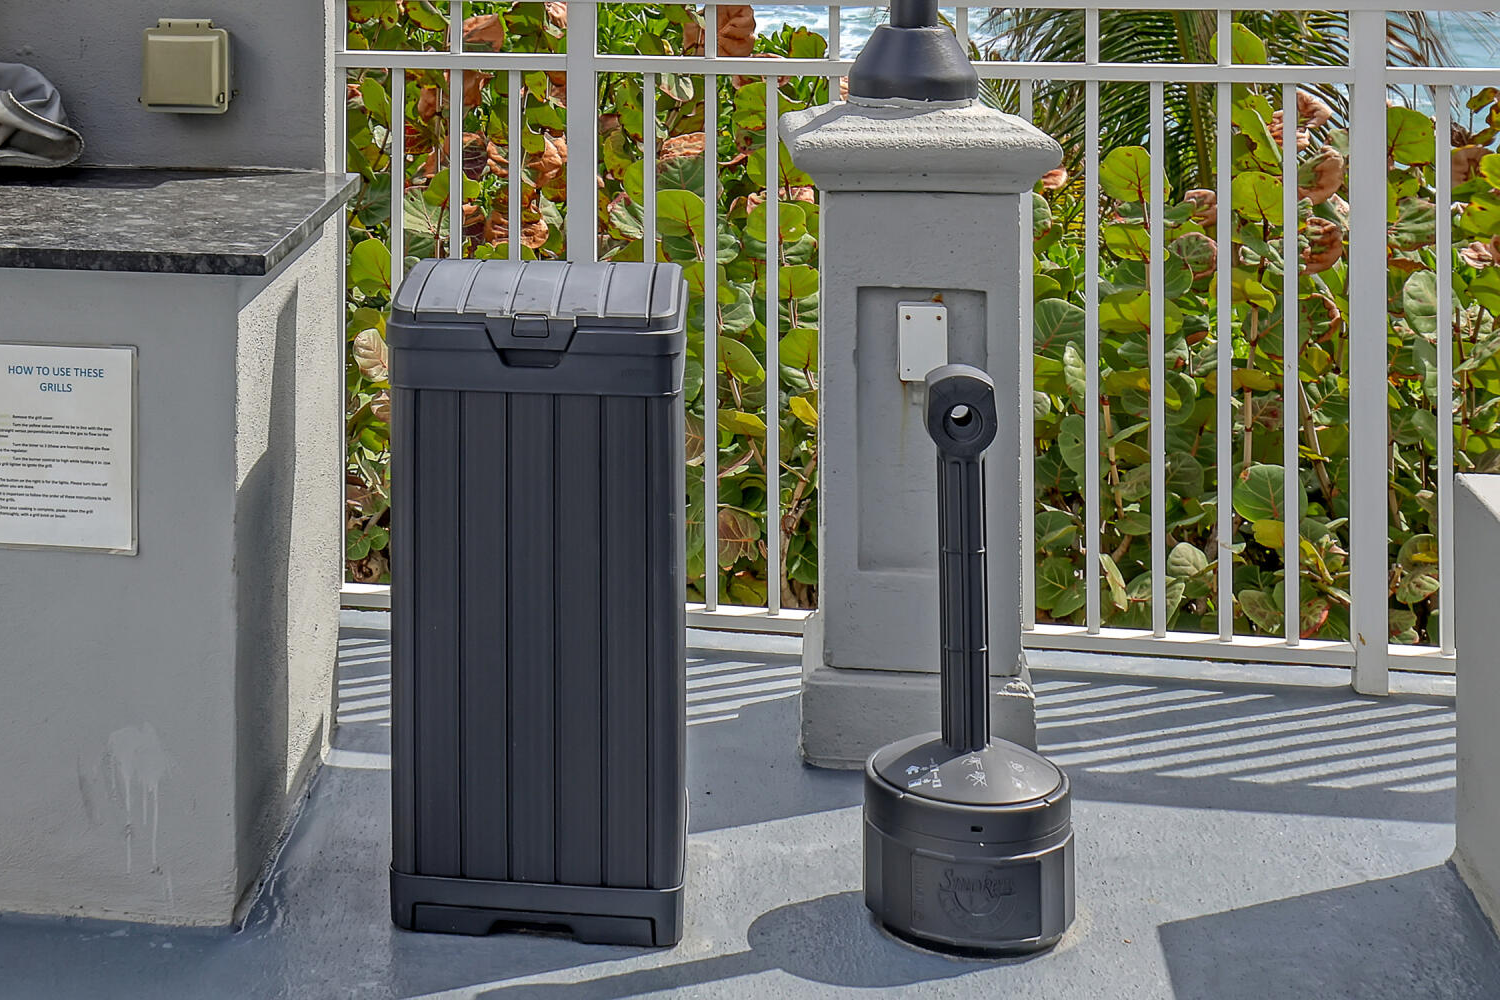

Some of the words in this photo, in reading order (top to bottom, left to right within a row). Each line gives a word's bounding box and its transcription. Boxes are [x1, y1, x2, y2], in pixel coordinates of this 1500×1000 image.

[8, 365, 33, 375] HOW
[36, 366, 49, 376] TO
[52, 367, 71, 377] USE
[74, 368, 104, 378] THESE
[39, 382, 72, 393] GRILLS
